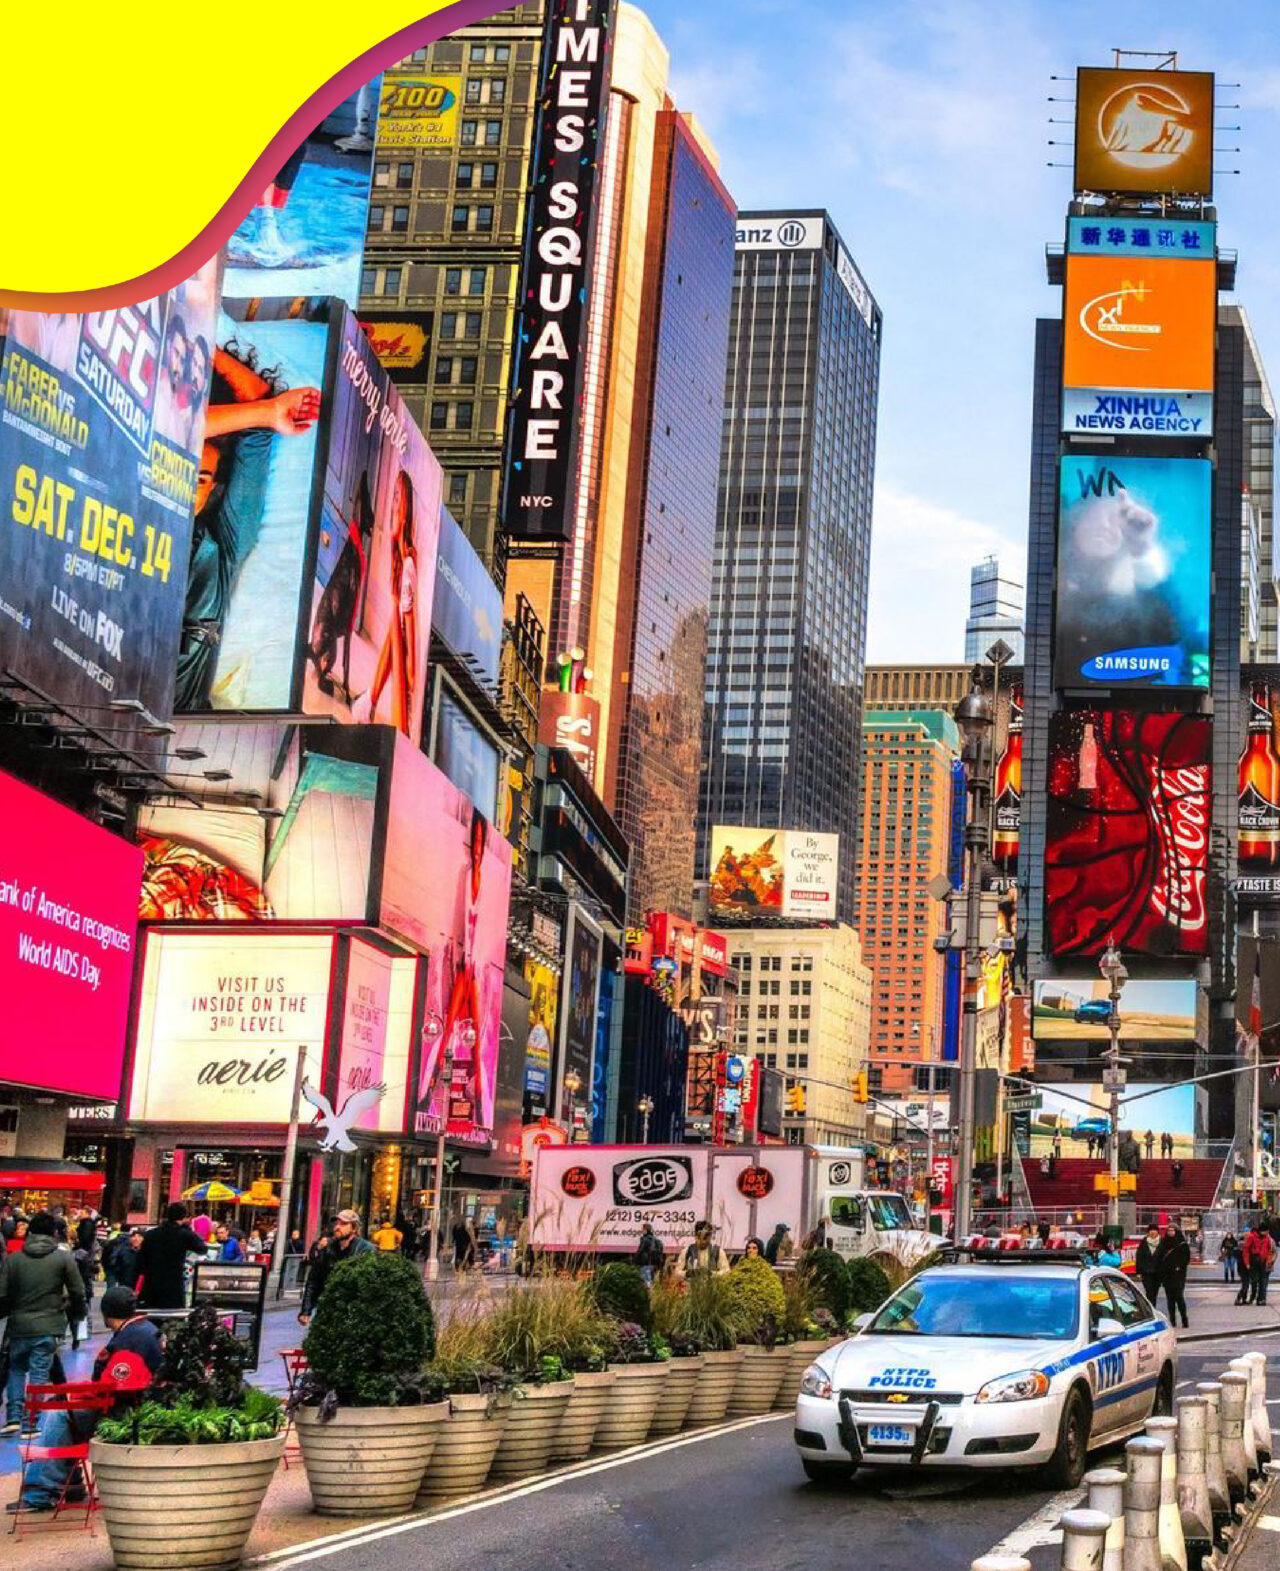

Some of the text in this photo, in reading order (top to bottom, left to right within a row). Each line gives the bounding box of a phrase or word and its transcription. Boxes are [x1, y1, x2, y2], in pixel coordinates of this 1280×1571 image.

[1081, 226, 1200, 248] 新华通讯社
[525, 181, 582, 460] SQUARE
[84, 305, 158, 398] UFC
[8, 352, 59, 399] FABER
[343, 340, 381, 433] merry
[79, 342, 149, 441] SATURDAY
[5, 379, 89, 450] McDONALD
[1095, 396, 1181, 416] XINHUA
[1075, 415, 1202, 431] NEWS AGENCY
[520, 495, 553, 508] NYC
[12, 464, 75, 543] SAT.
[80, 495, 136, 570] DEC.
[141, 524, 172, 584] 14
[51, 585, 77, 625] LIVE
[79, 613, 95, 639] ON
[95, 609, 125, 662] FOX
[1095, 656, 1170, 671] SAMSUNG
[806, 837, 819, 850] By
[790, 849, 833, 863] George,
[22, 886, 37, 912] of
[36, 891, 80, 931] America
[82, 917, 131, 952] recognizes
[19, 932, 52, 968] World
[52, 946, 79, 978] AIDS
[218, 977, 285, 992] VISIT US
[192, 997, 307, 1012] INSIDE ON THE
[240, 1017, 285, 1032] LEVEL
[197, 1049, 287, 1085] aerie
[628, 1168, 677, 1191] edge
[606, 1210, 696, 1223] (212) 947-3343
[868, 1376, 937, 1388] POLICE
[883, 1368, 930, 1376] NYPD
[1098, 1351, 1125, 1391] NYPD
